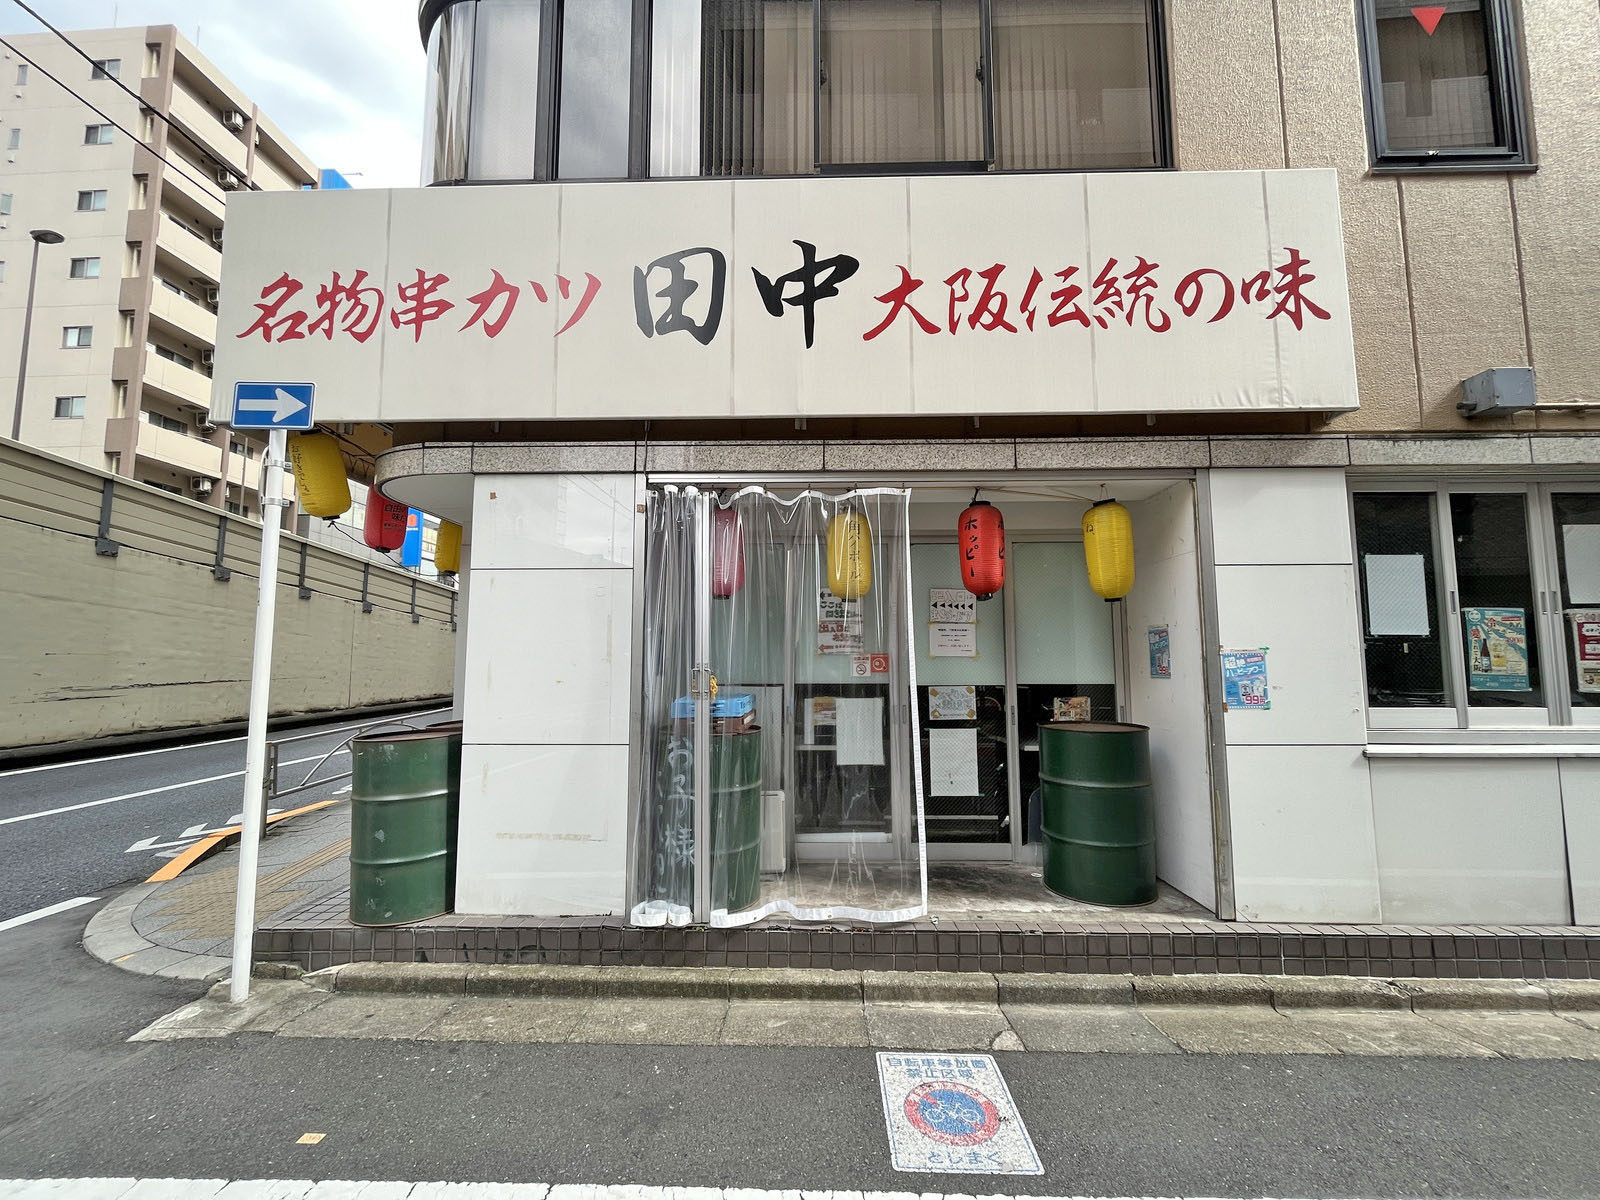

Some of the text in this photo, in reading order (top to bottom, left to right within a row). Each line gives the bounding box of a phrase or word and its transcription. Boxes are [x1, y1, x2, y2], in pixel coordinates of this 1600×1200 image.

[237, 239, 1331, 350] 名物串カツ 田中 大阪伝統の味
[964, 517, 980, 577] ホッピー
[906, 1068, 975, 1080] 禁止区域
